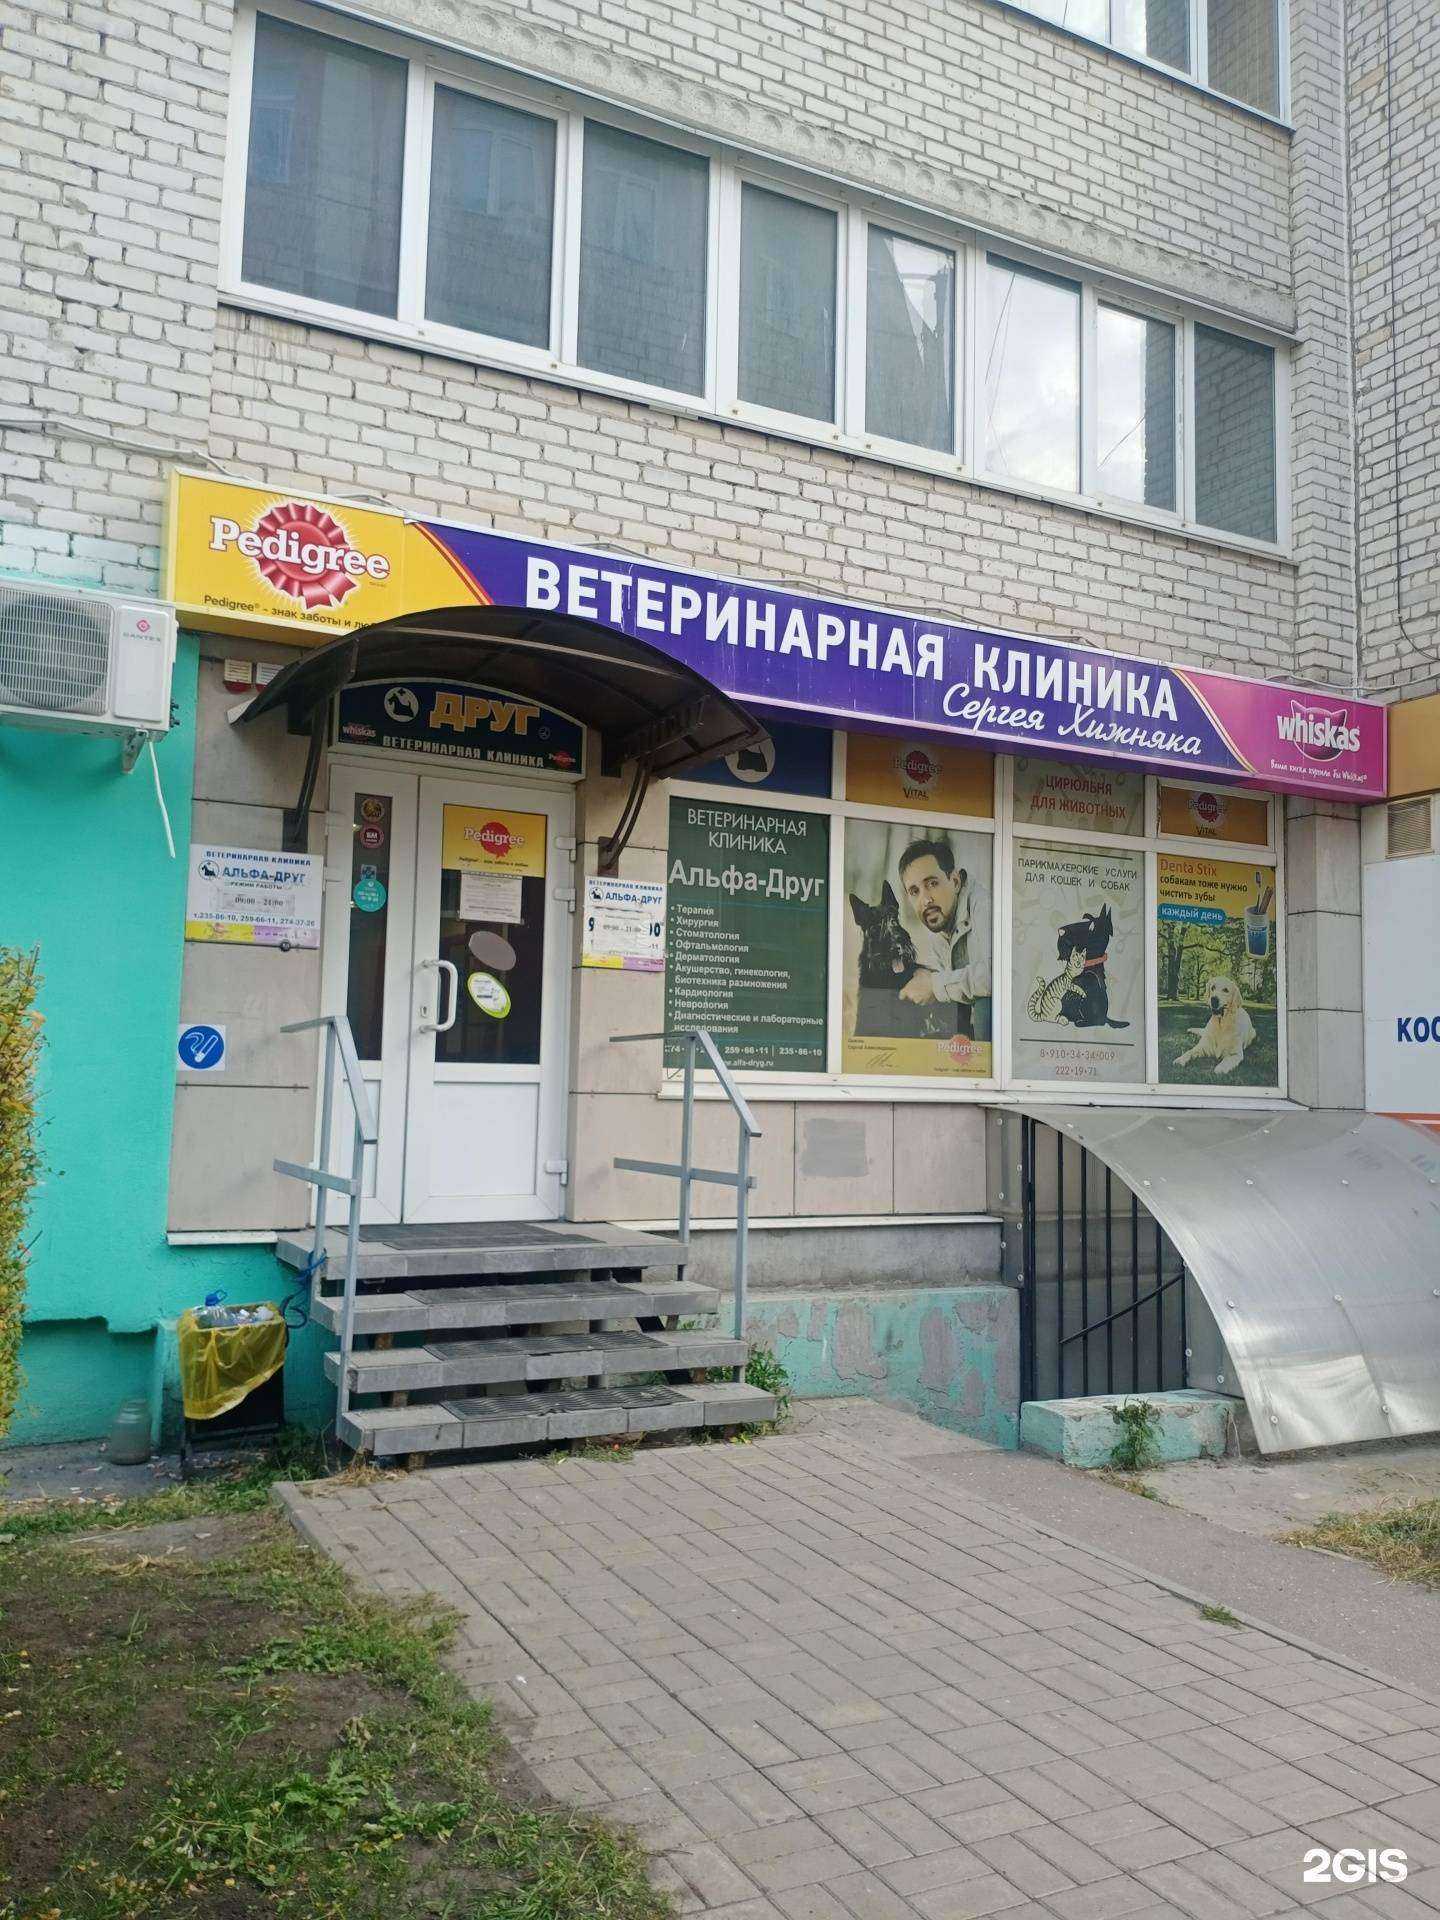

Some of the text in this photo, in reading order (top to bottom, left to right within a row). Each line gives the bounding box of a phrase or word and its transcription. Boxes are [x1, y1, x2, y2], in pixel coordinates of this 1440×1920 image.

[209, 516, 391, 582] Pedigree
[271, 607, 298, 620] знак
[300, 613, 341, 626] заботы
[344, 618, 351, 627] и
[526, 557, 1178, 722] ВЕТЕРИНАРНАЯ КЛИНИКА
[429, 691, 541, 736] ДРУГ
[942, 683, 1202, 755] Сергея Хижняка
[383, 736, 545, 768] ВЕТЕРИНАРНАЯ КЛИНИКА
[1046, 775, 1112, 796] ЦИРЮЛЬНЯ
[1031, 795, 1126, 819] ДЛЯ ЖИВОТНЫХ
[687, 808, 807, 836] ВЕТЕРИНАРНАЯ
[464, 827, 525, 847] Pedigree
[708, 831, 787, 855] КЛИНИКА
[222, 867, 306, 884] АЛЬФА-ДРУГ
[1018, 858, 1137, 880] ПАРИКМАХЕРСКИЕ УСЛУГИ
[1160, 858, 1217, 877] Denta Stix
[668, 859, 825, 902] Альфа-Друг
[1025, 872, 1131, 891] ДЛЯ КОШЕК И СОБАК
[1160, 875, 1248, 893] собакам тоже нужно
[605, 892, 663, 905] АЛЬФА-ДРУГ
[1160, 889, 1216, 903] чистить зубы
[676, 904, 714, 915] Терапия
[1161, 906, 1223, 922] каждый день
[676, 915, 719, 928] Хирургия
[676, 928, 740, 940] Стоматология
[675, 939, 749, 953] Офтальмология
[675, 951, 740, 964] Дерматология
[675, 963, 732, 976] Акушерство,
[675, 974, 788, 990] биотехника размножения
[674, 986, 733, 998] Кардиология
[674, 999, 728, 1010] Неврология
[673, 1010, 751, 1023] Диагностические
[760, 1015, 824, 1026] лабораторные
